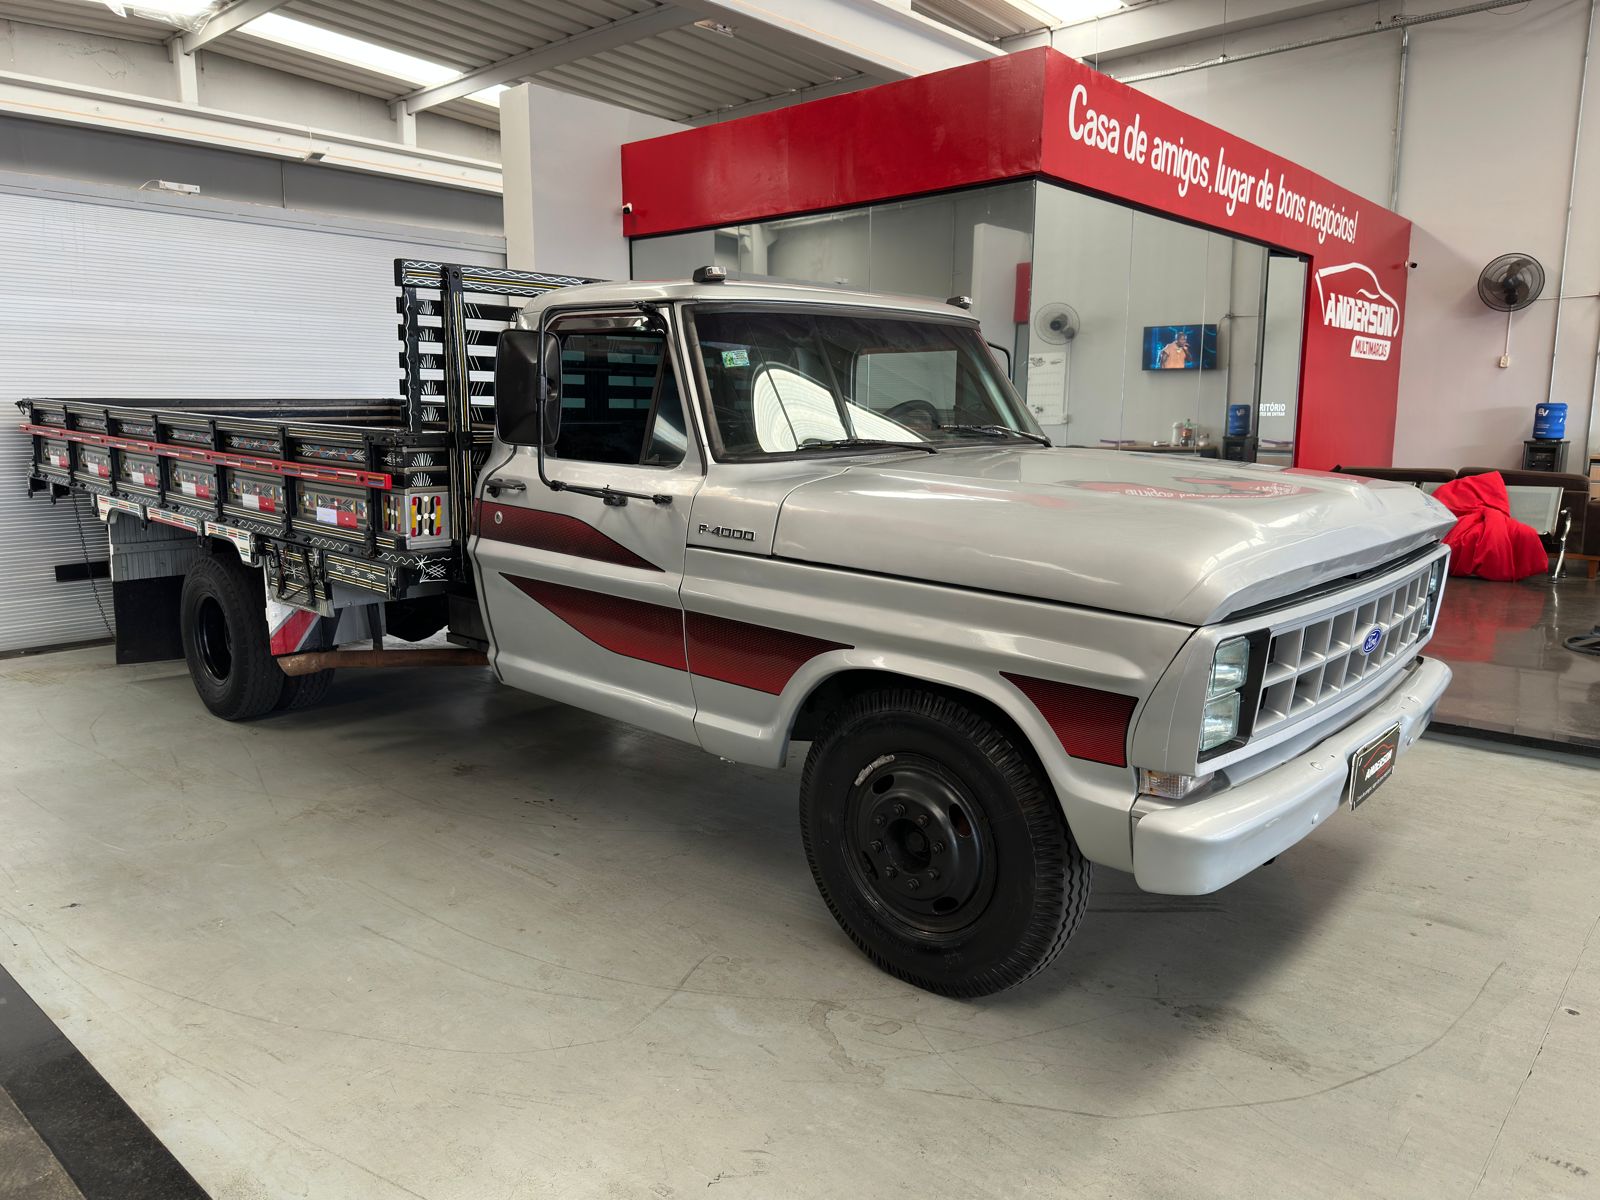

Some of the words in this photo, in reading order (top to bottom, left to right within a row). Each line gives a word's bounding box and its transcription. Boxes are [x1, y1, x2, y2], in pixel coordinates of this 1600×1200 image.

[1068, 84, 1120, 154] Casa
[1123, 113, 1147, 164] de
[1151, 137, 1212, 197] amigos,
[1214, 148, 1255, 216] lugar
[1256, 168, 1274, 211] de
[1275, 173, 1306, 223] bons
[1306, 200, 1359, 244] negócios!
[1324, 292, 1394, 337] ANDERSON
[1354, 339, 1388, 357] MULTIMARCAS
[698, 523, 756, 541] F-4000
